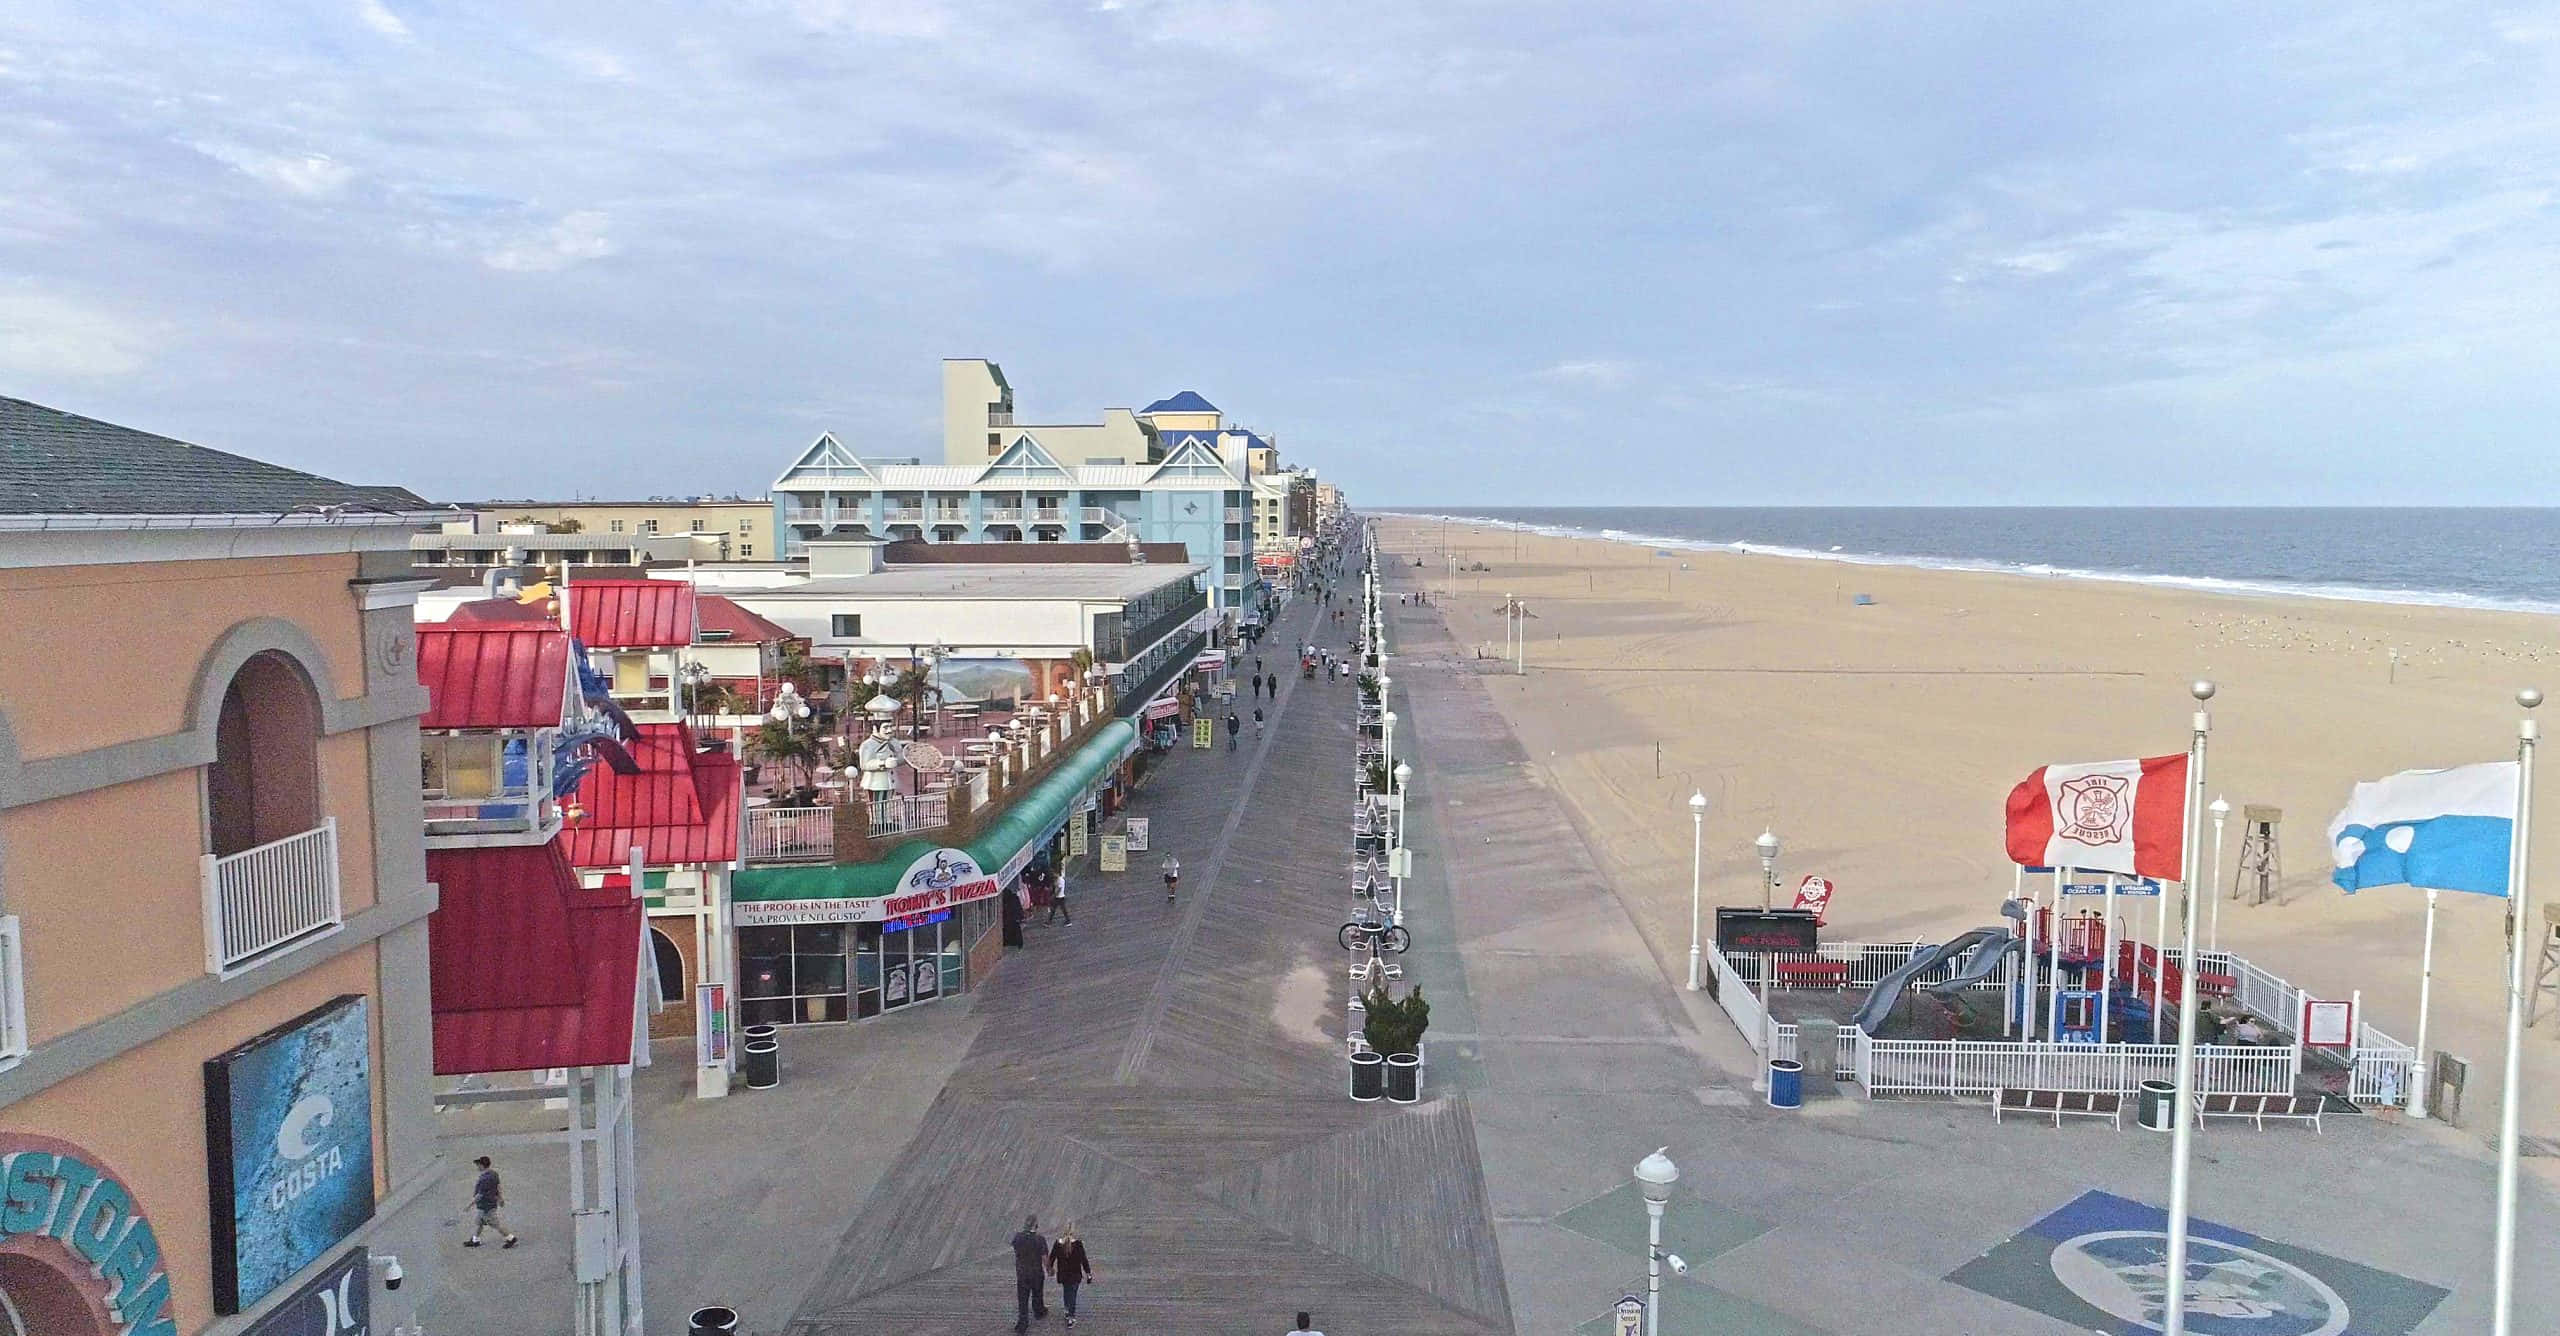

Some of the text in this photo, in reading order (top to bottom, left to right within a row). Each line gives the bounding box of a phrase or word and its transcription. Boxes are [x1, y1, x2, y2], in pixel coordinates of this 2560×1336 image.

[763, 902, 796, 912] PROOF
[800, 902, 809, 911] IS
[811, 901, 821, 910] IN
[824, 901, 841, 910] THE
[883, 880, 998, 916] TONY'S PIZZA
[767, 914, 798, 923] PROVA
[809, 912, 824, 921] NEL
[271, 1145, 343, 1210] COSTA
